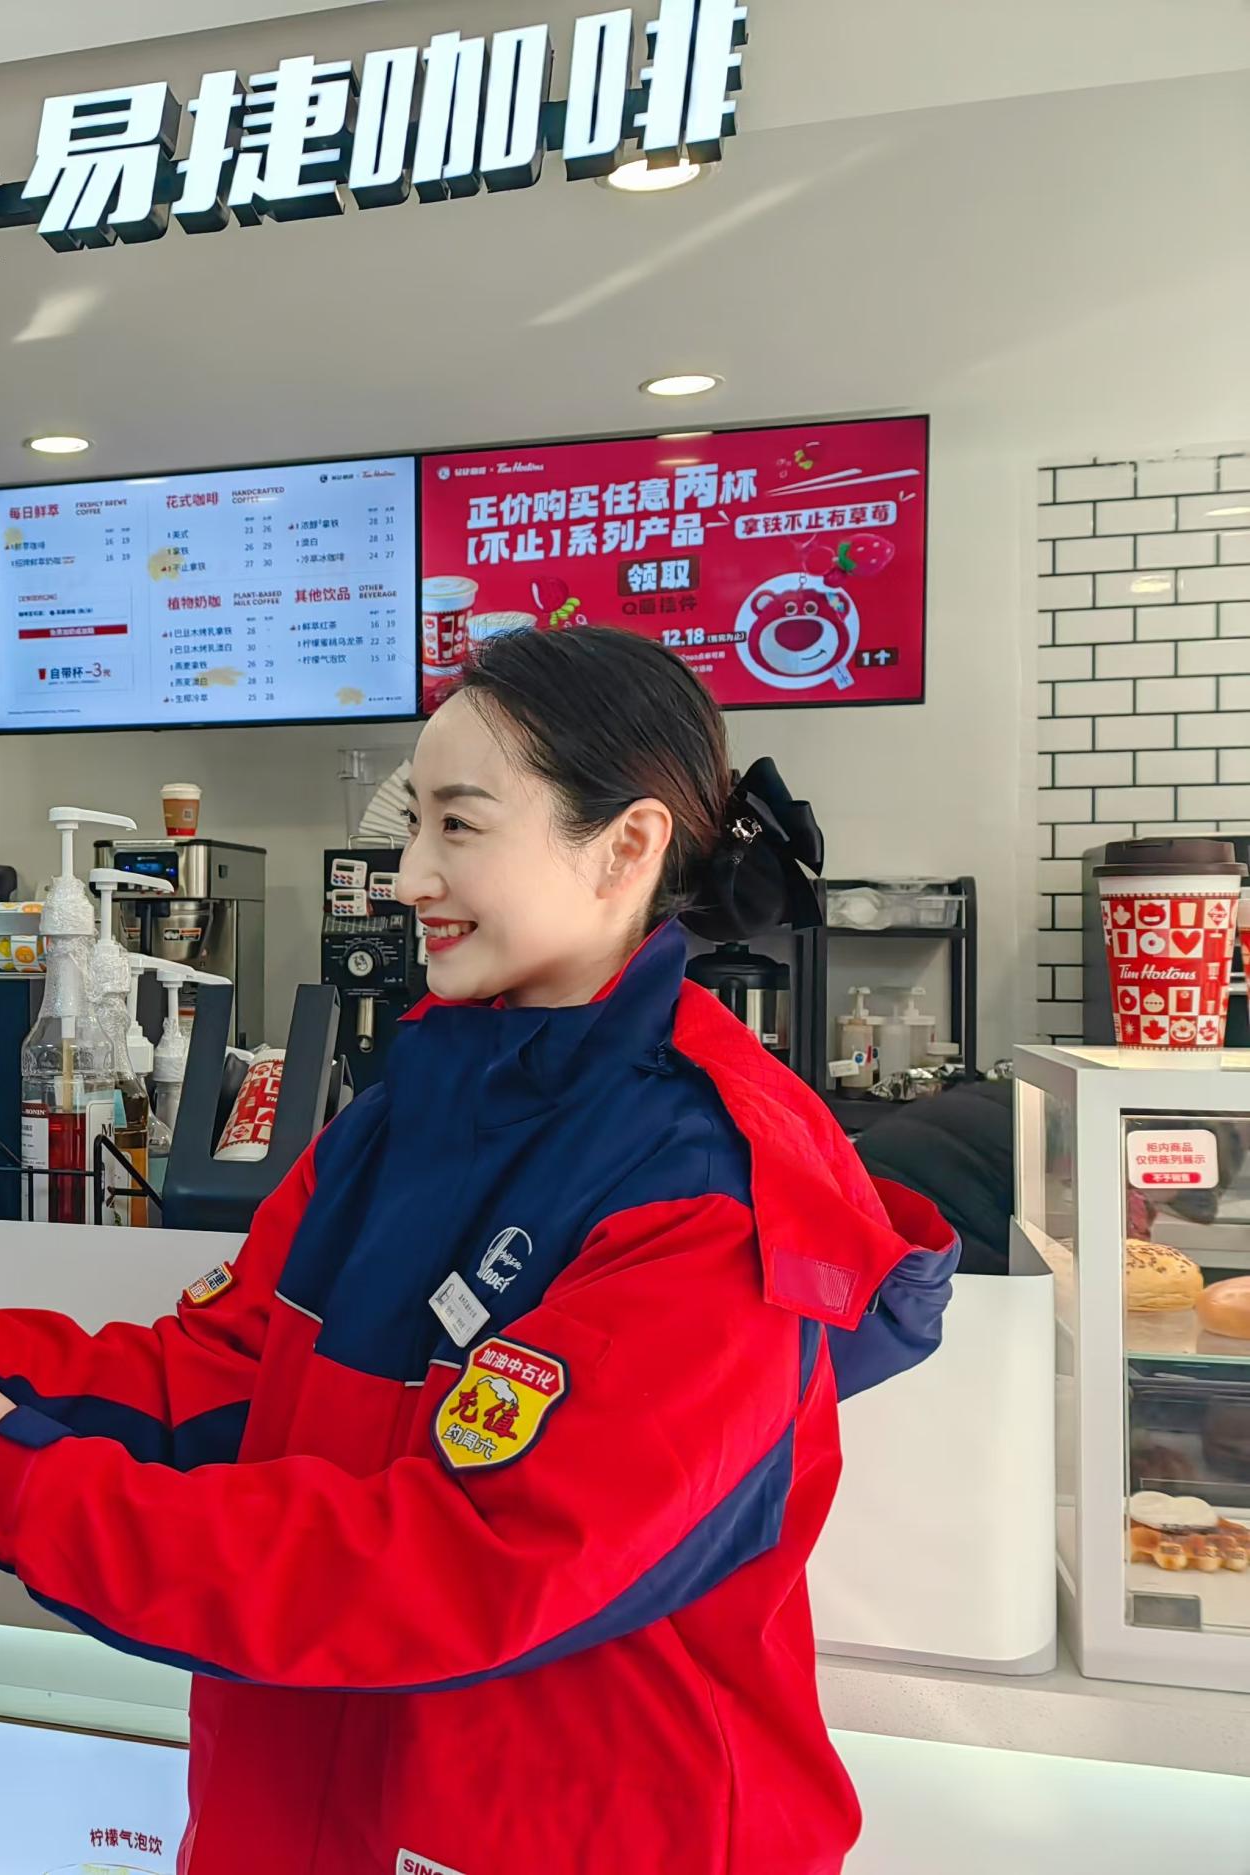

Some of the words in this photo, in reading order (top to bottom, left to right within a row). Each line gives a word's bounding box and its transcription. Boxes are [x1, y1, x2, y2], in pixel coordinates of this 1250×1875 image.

[21, 0, 748, 236] 易捷咖啡
[166, 491, 218, 509] 花式咖啡
[232, 486, 285, 497] HANDCRAFTED
[467, 463, 758, 530] 正价购买任意两杯
[9, 504, 59, 520] 每日鲜萃
[76, 508, 101, 516] COFFEE
[742, 504, 891, 536] 拿铁不止有草莓
[627, 558, 690, 593] 领取
[233, 590, 282, 599] PLANT-BASED
[295, 586, 350, 604] 其他饮品
[359, 583, 384, 591] OTHER
[359, 590, 397, 599] BEVERAGE
[168, 595, 221, 610] 植物奶咖
[233, 599, 251, 607] MILK
[252, 598, 280, 606] COFFEE
[662, 627, 704, 647] 12.18
[1118, 964, 1139, 979] Tim
[1140, 963, 1196, 980] Hortons
[1147, 1142, 1194, 1152] 柜内商品
[479, 1348, 556, 1390] 加油中石化
[449, 1385, 521, 1440] 充值
[443, 1424, 498, 1459] 约周六
[90, 1828, 162, 1856] 柠檬气泡饮
